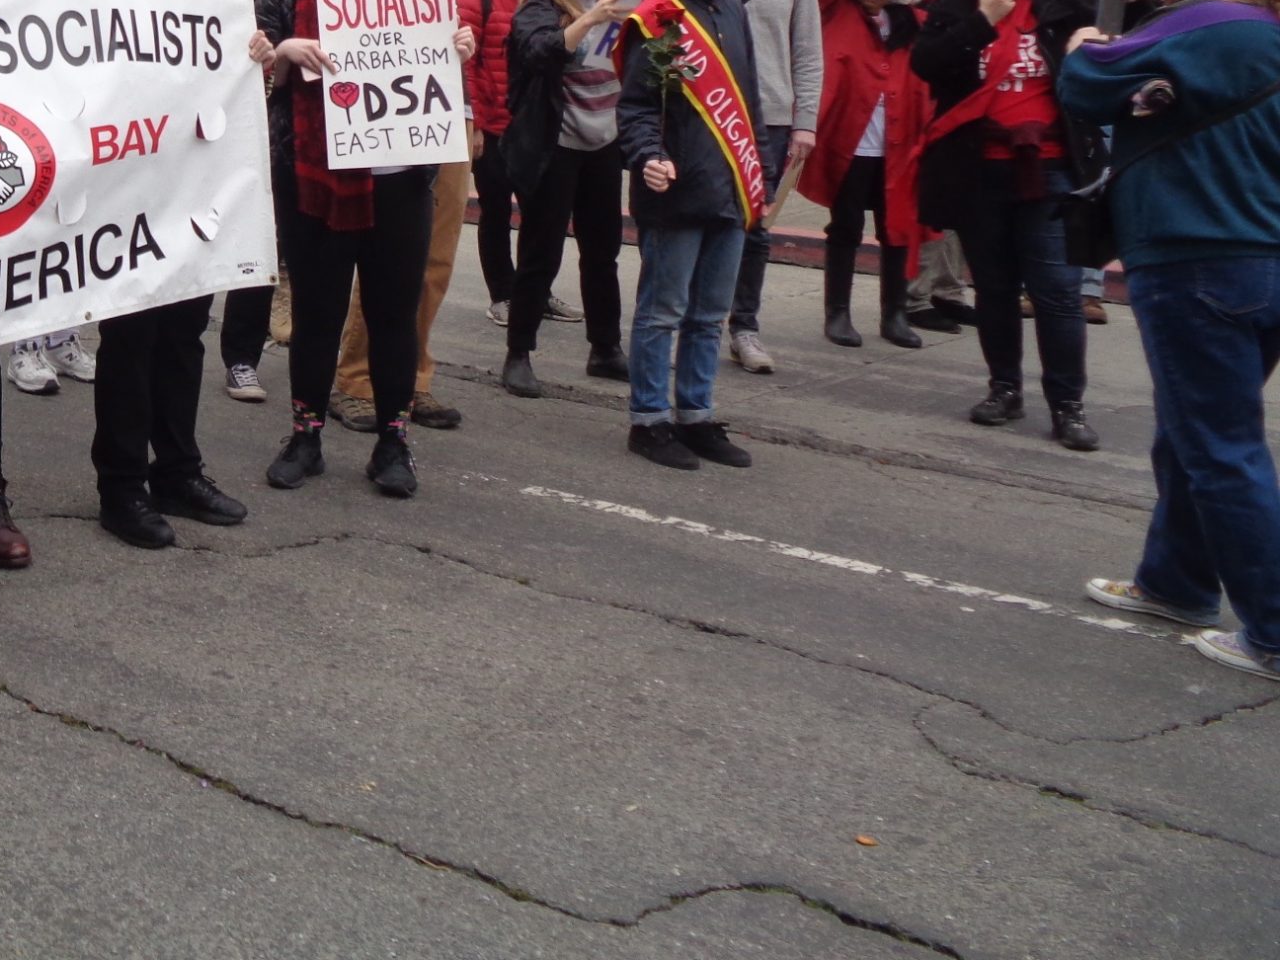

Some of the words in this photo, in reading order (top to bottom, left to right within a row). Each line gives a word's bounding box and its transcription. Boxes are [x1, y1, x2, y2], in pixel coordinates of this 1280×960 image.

[328, 46, 449, 73] BARBARISM
[359, 32, 405, 47] OVER
[363, 74, 452, 122] DSA
[89, 114, 169, 166] BAY
[334, 128, 394, 156] EAST
[408, 121, 451, 148] BAY
[706, 88, 764, 208] OLIGARCH
[27, 145, 52, 208] AMERICA
